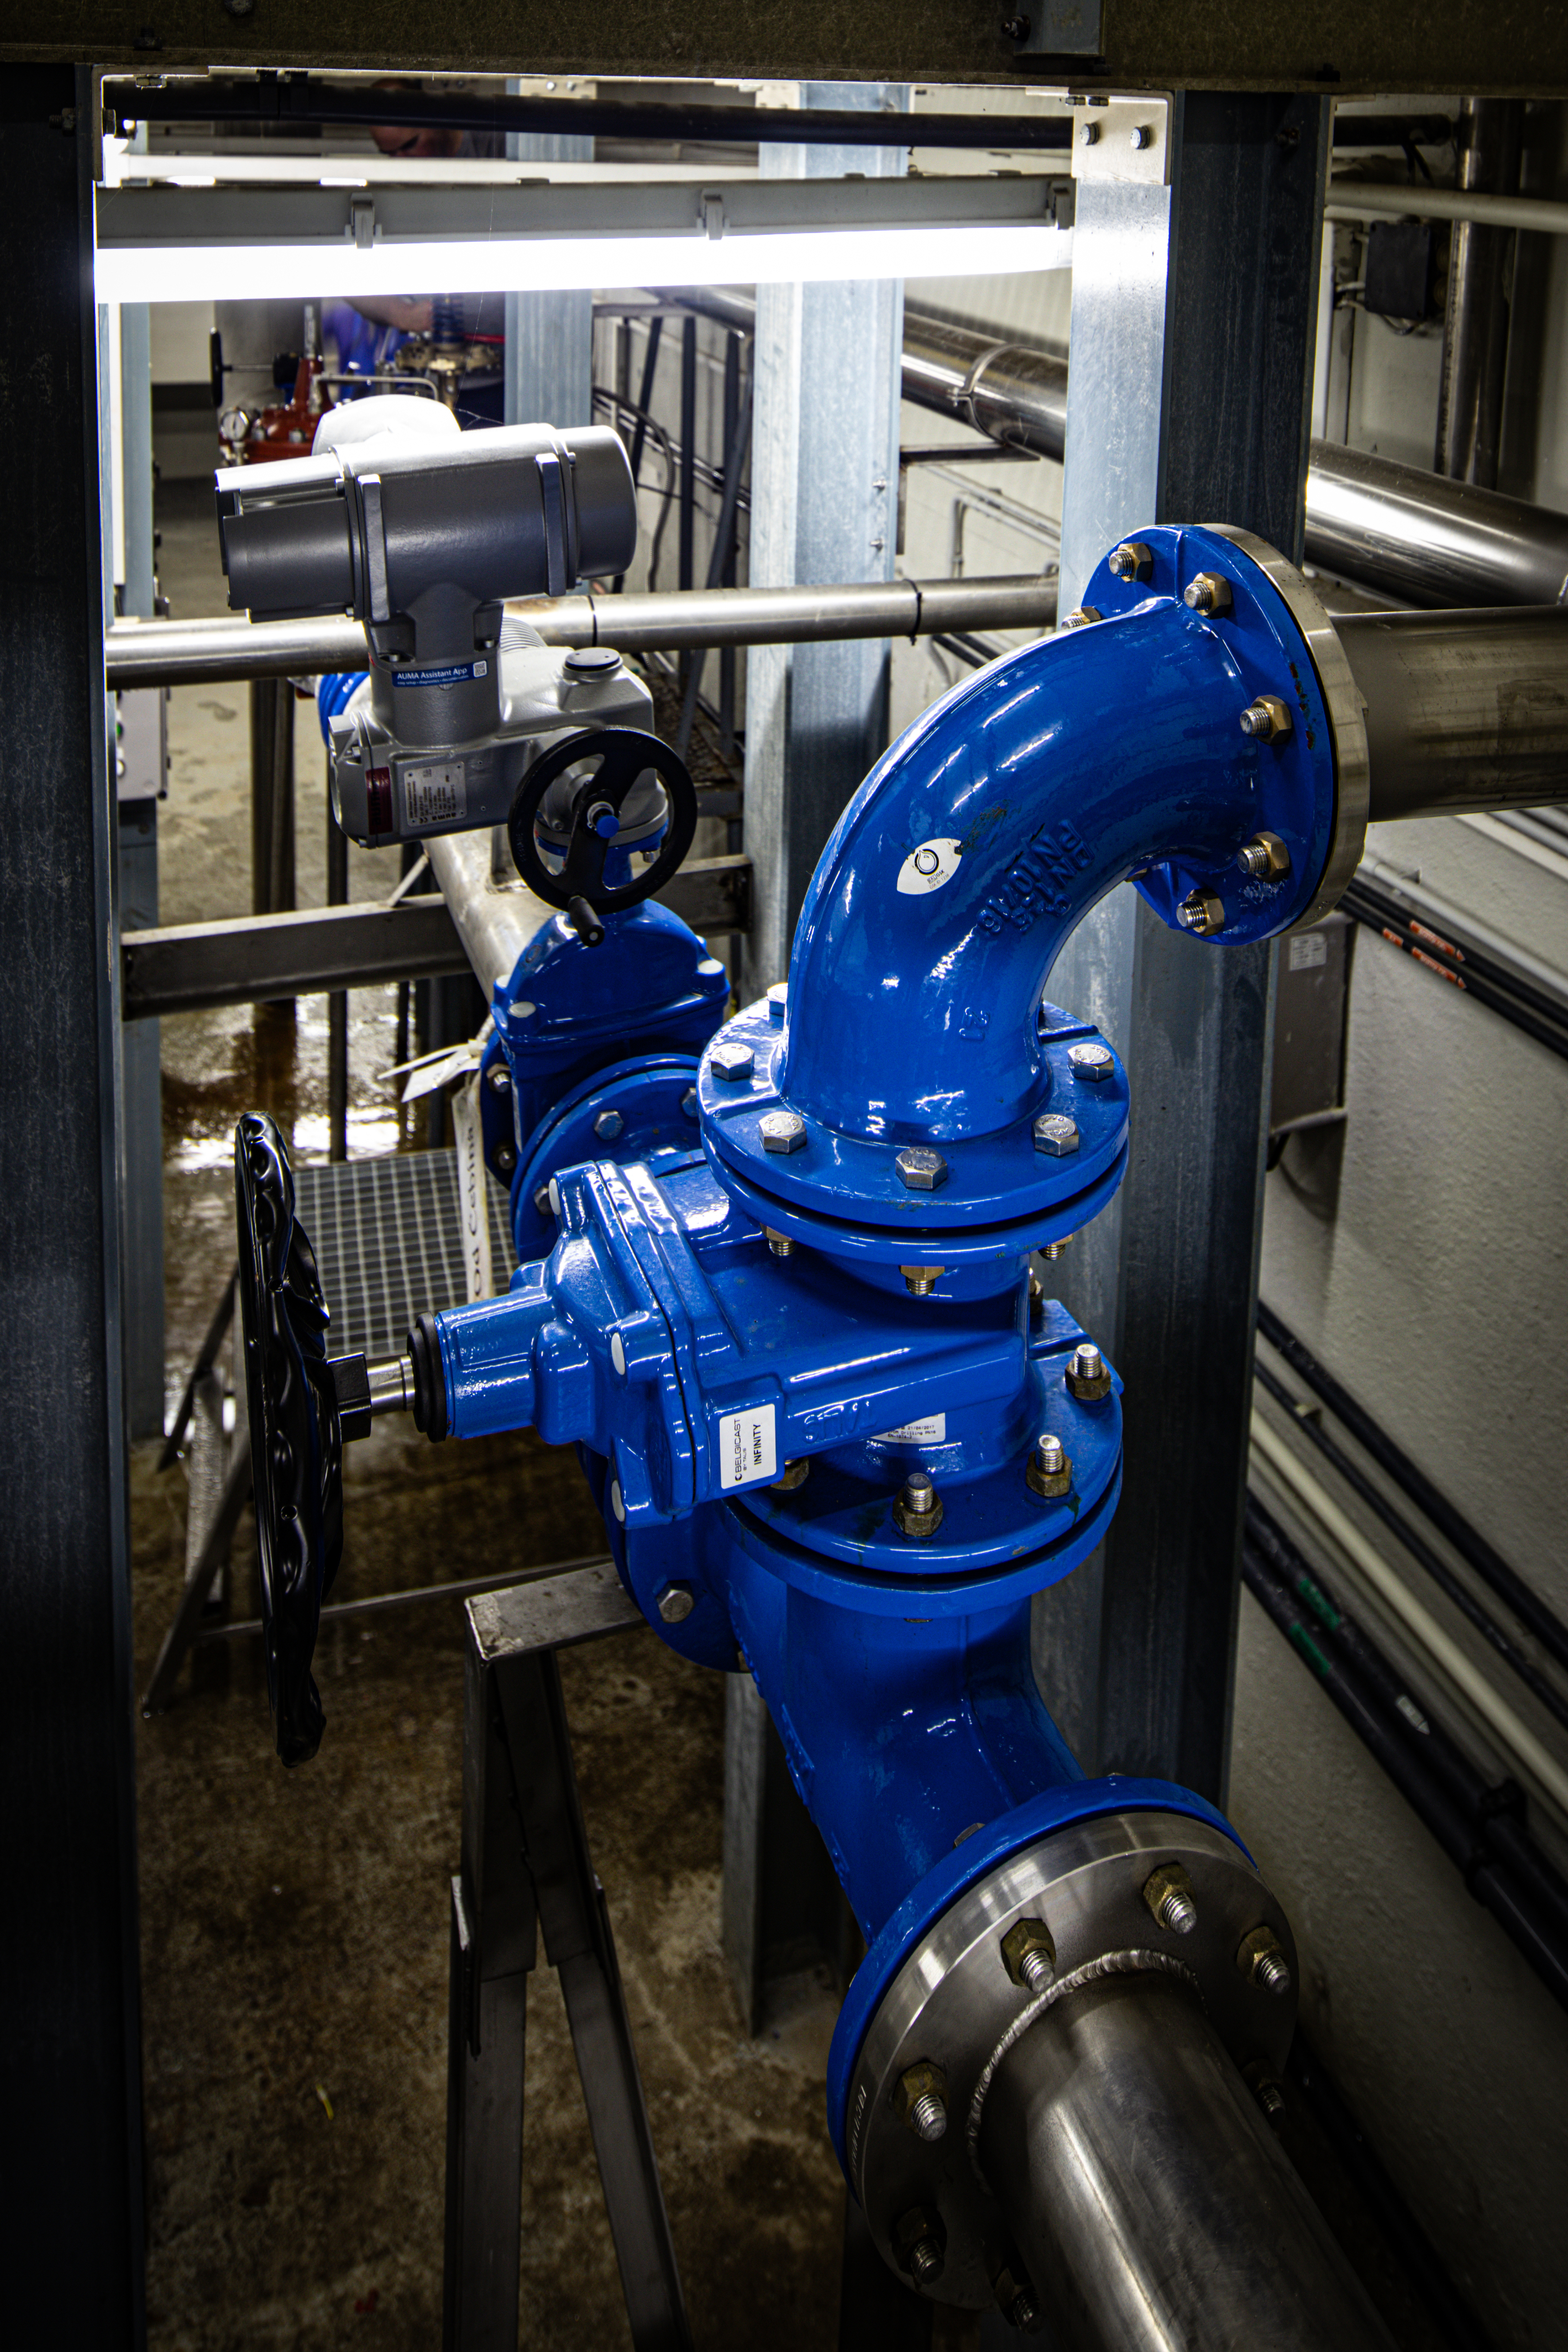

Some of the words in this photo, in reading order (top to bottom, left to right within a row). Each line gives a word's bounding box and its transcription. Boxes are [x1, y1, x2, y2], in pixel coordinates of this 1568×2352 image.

[421, 670, 452, 679] Assistant
[453, 667, 467, 675] App
[753, 1423, 762, 1465] INFINITY
[743, 1462, 747, 1471] BY
